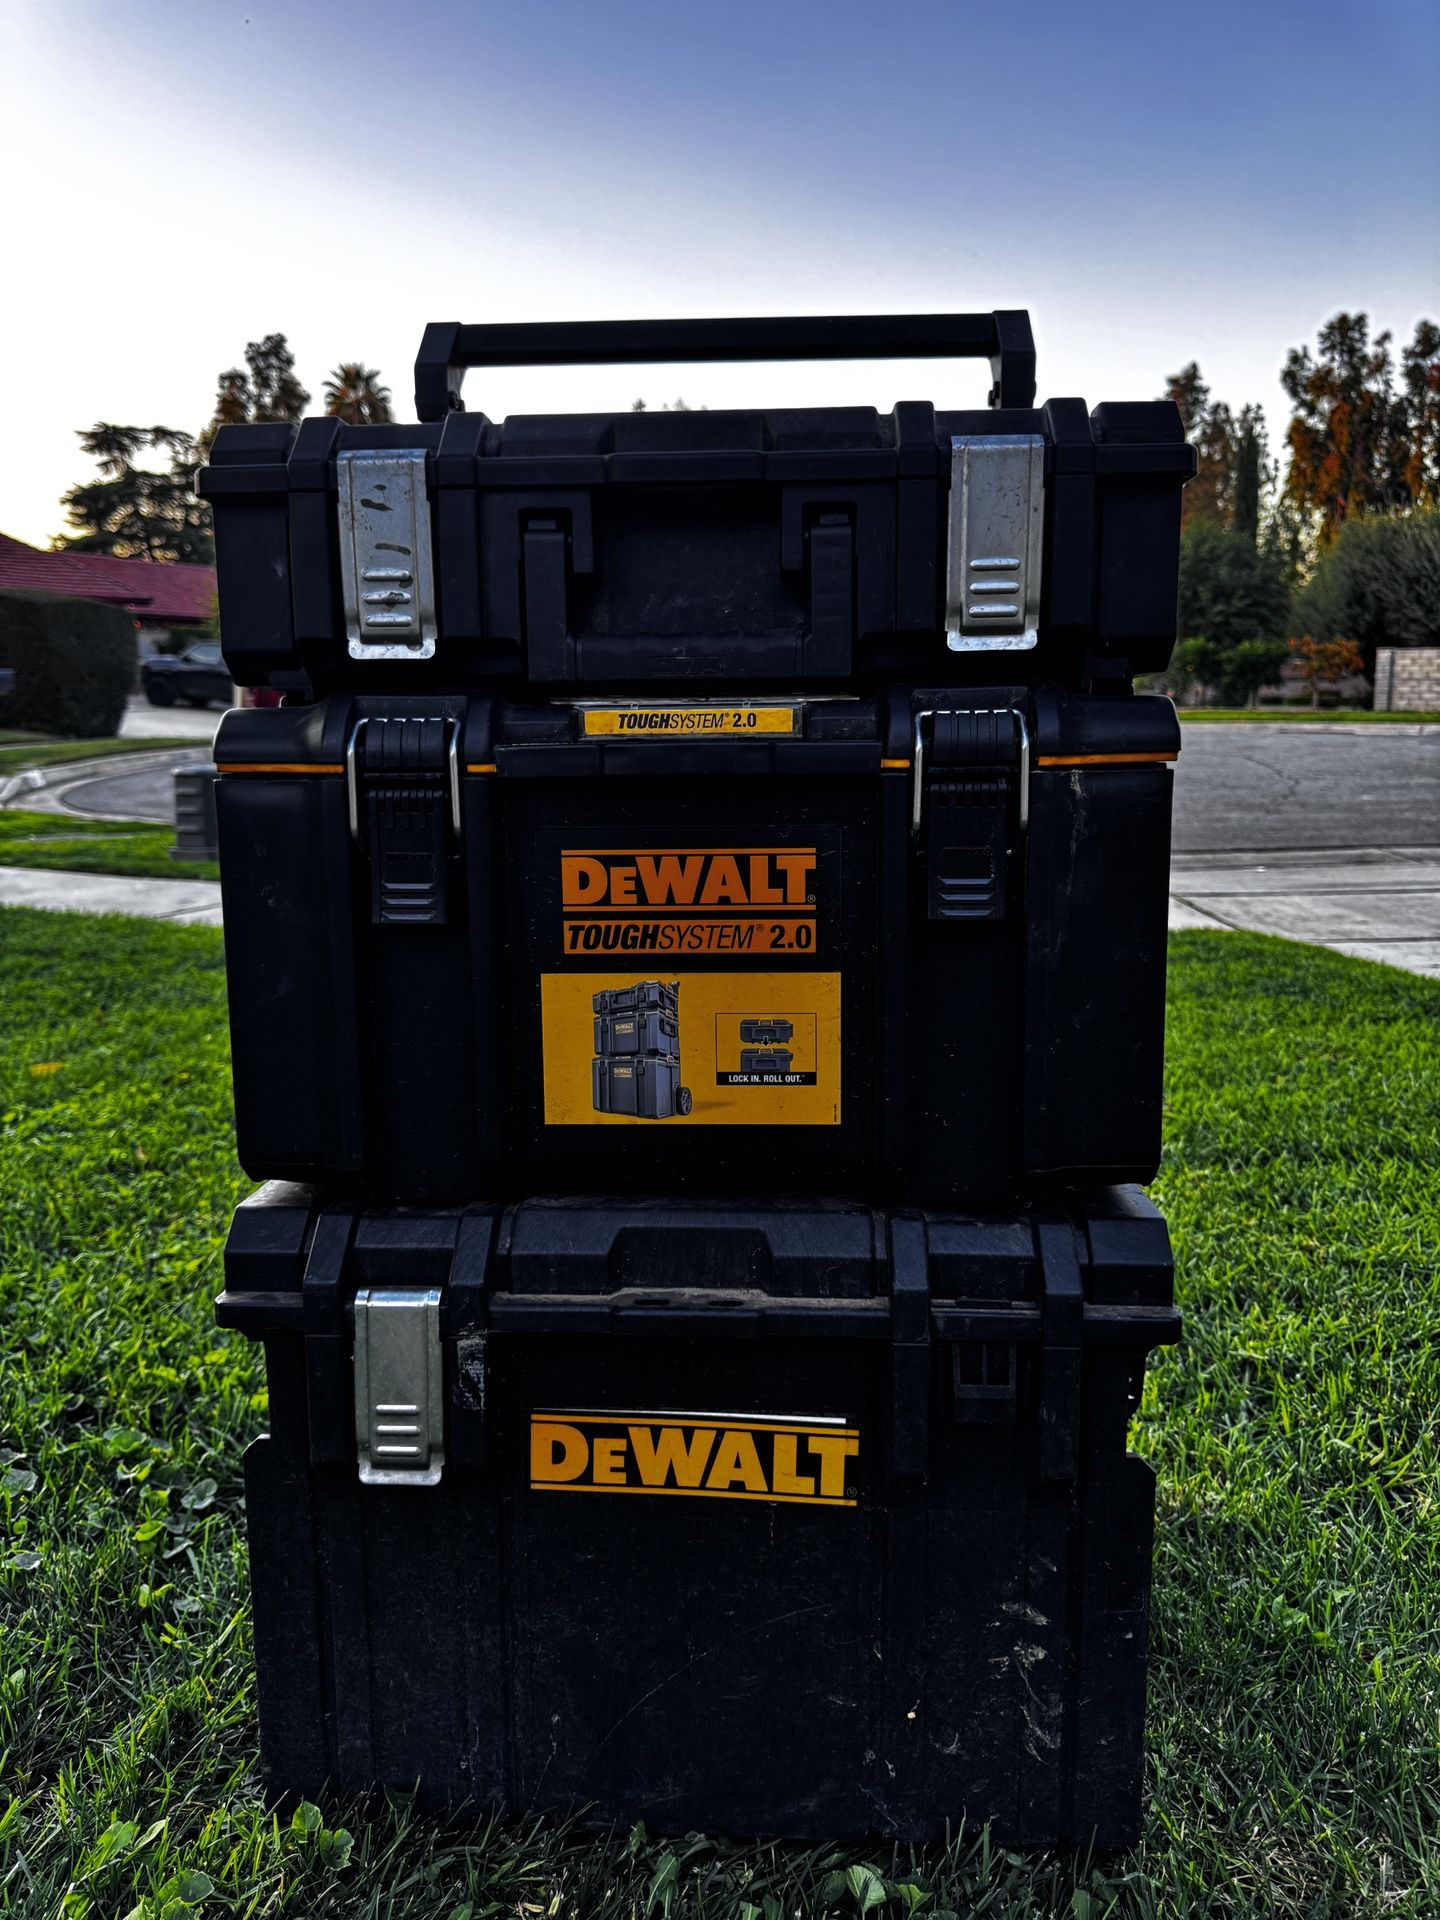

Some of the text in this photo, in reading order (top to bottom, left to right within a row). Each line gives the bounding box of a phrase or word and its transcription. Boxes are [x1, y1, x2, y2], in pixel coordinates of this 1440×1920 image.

[732, 712, 757, 728] 2.0
[769, 924, 812, 949] 2.0
[728, 1074, 749, 1083] LOCK
[750, 1074, 762, 1083] IN.
[763, 1074, 783, 1083] ROLL
